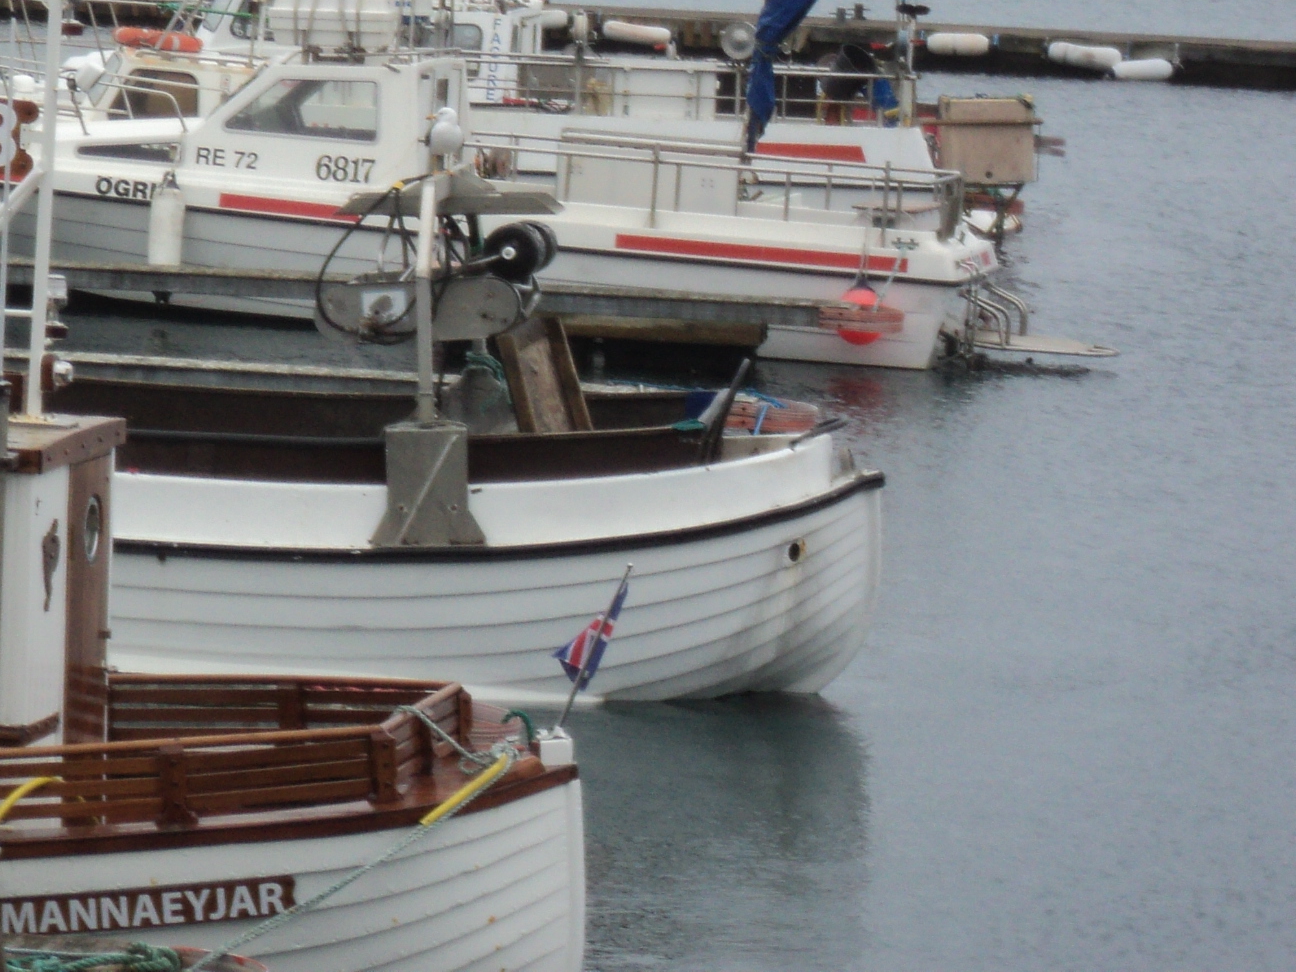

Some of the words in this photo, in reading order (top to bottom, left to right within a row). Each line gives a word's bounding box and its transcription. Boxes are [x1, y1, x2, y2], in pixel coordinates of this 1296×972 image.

[195, 146, 225, 167] RE
[234, 151, 258, 170] 72
[315, 155, 376, 184] 6817
[1, 881, 287, 934] MANNAEYJAR
